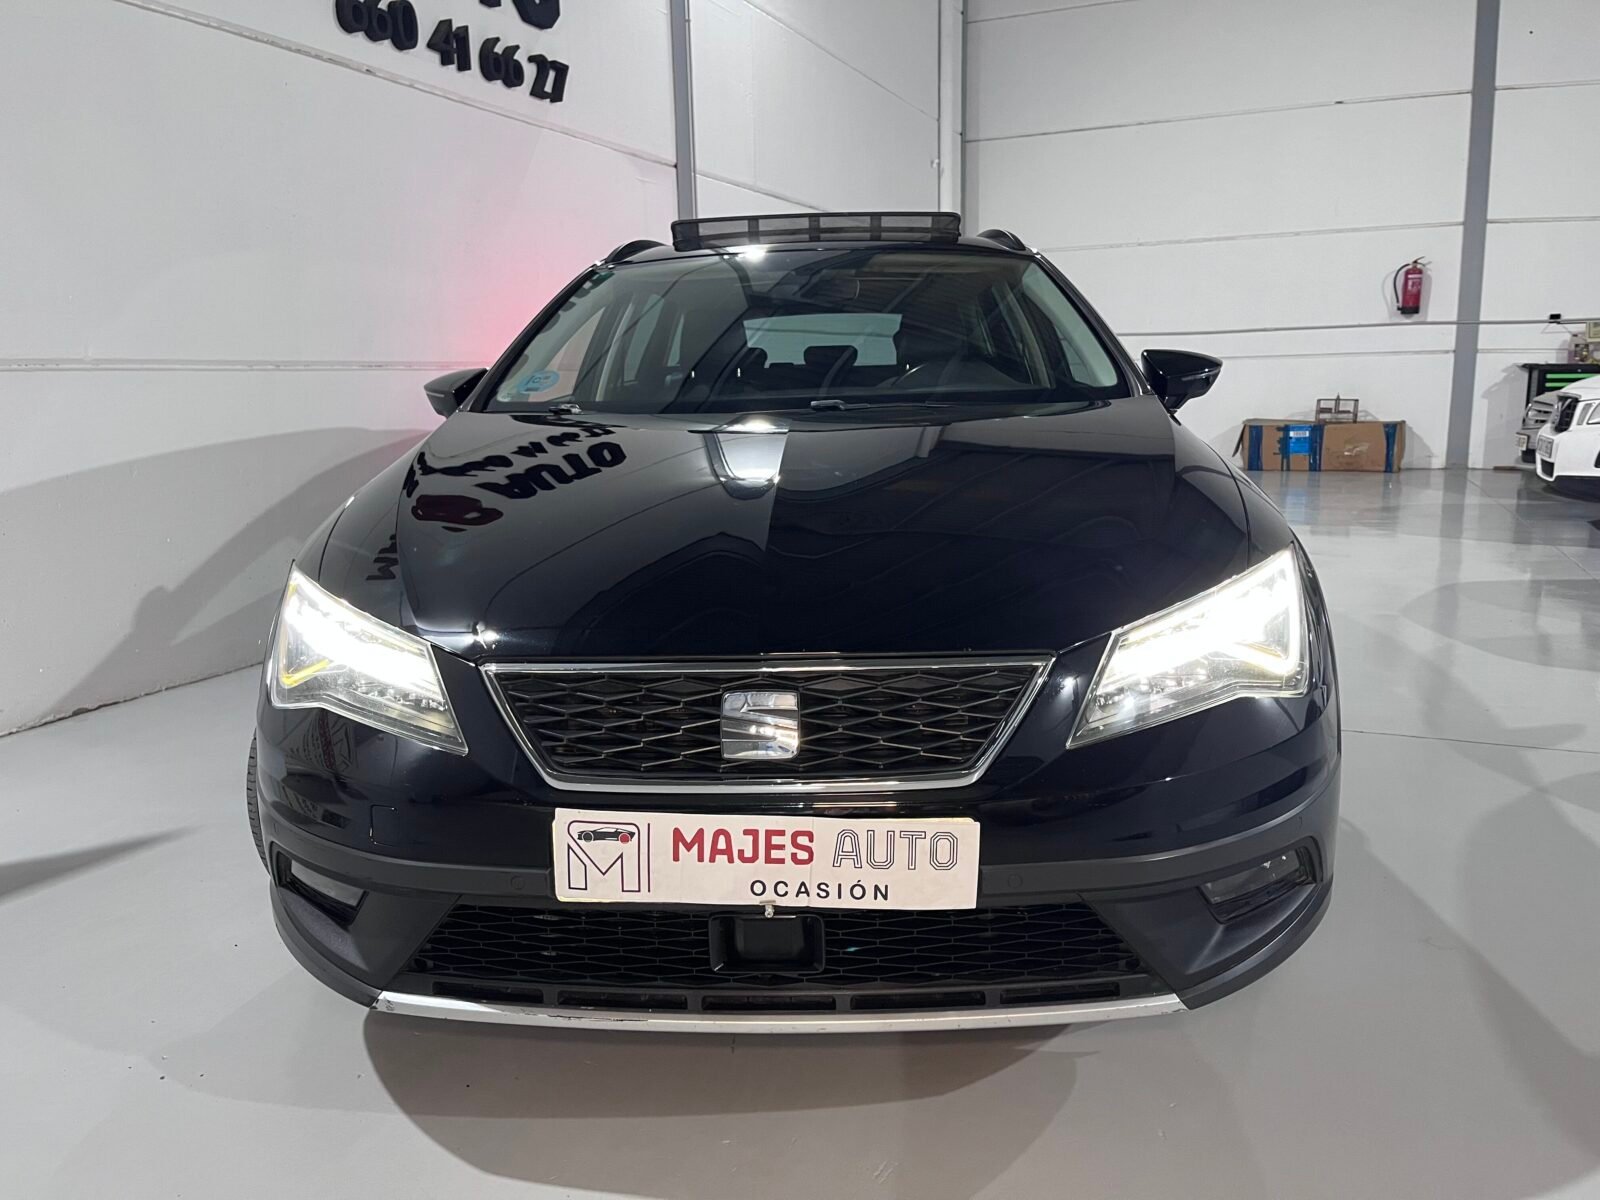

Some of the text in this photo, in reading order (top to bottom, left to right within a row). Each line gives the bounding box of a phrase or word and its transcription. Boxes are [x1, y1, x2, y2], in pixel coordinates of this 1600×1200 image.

[335, 0, 418, 50] 660
[427, 18, 472, 72] 41
[479, 37, 525, 88] 66
[527, 54, 570, 103] 27
[671, 827, 815, 866] MAJES
[831, 829, 960, 871] AUTO
[749, 879, 890, 901] OCASIÓN
